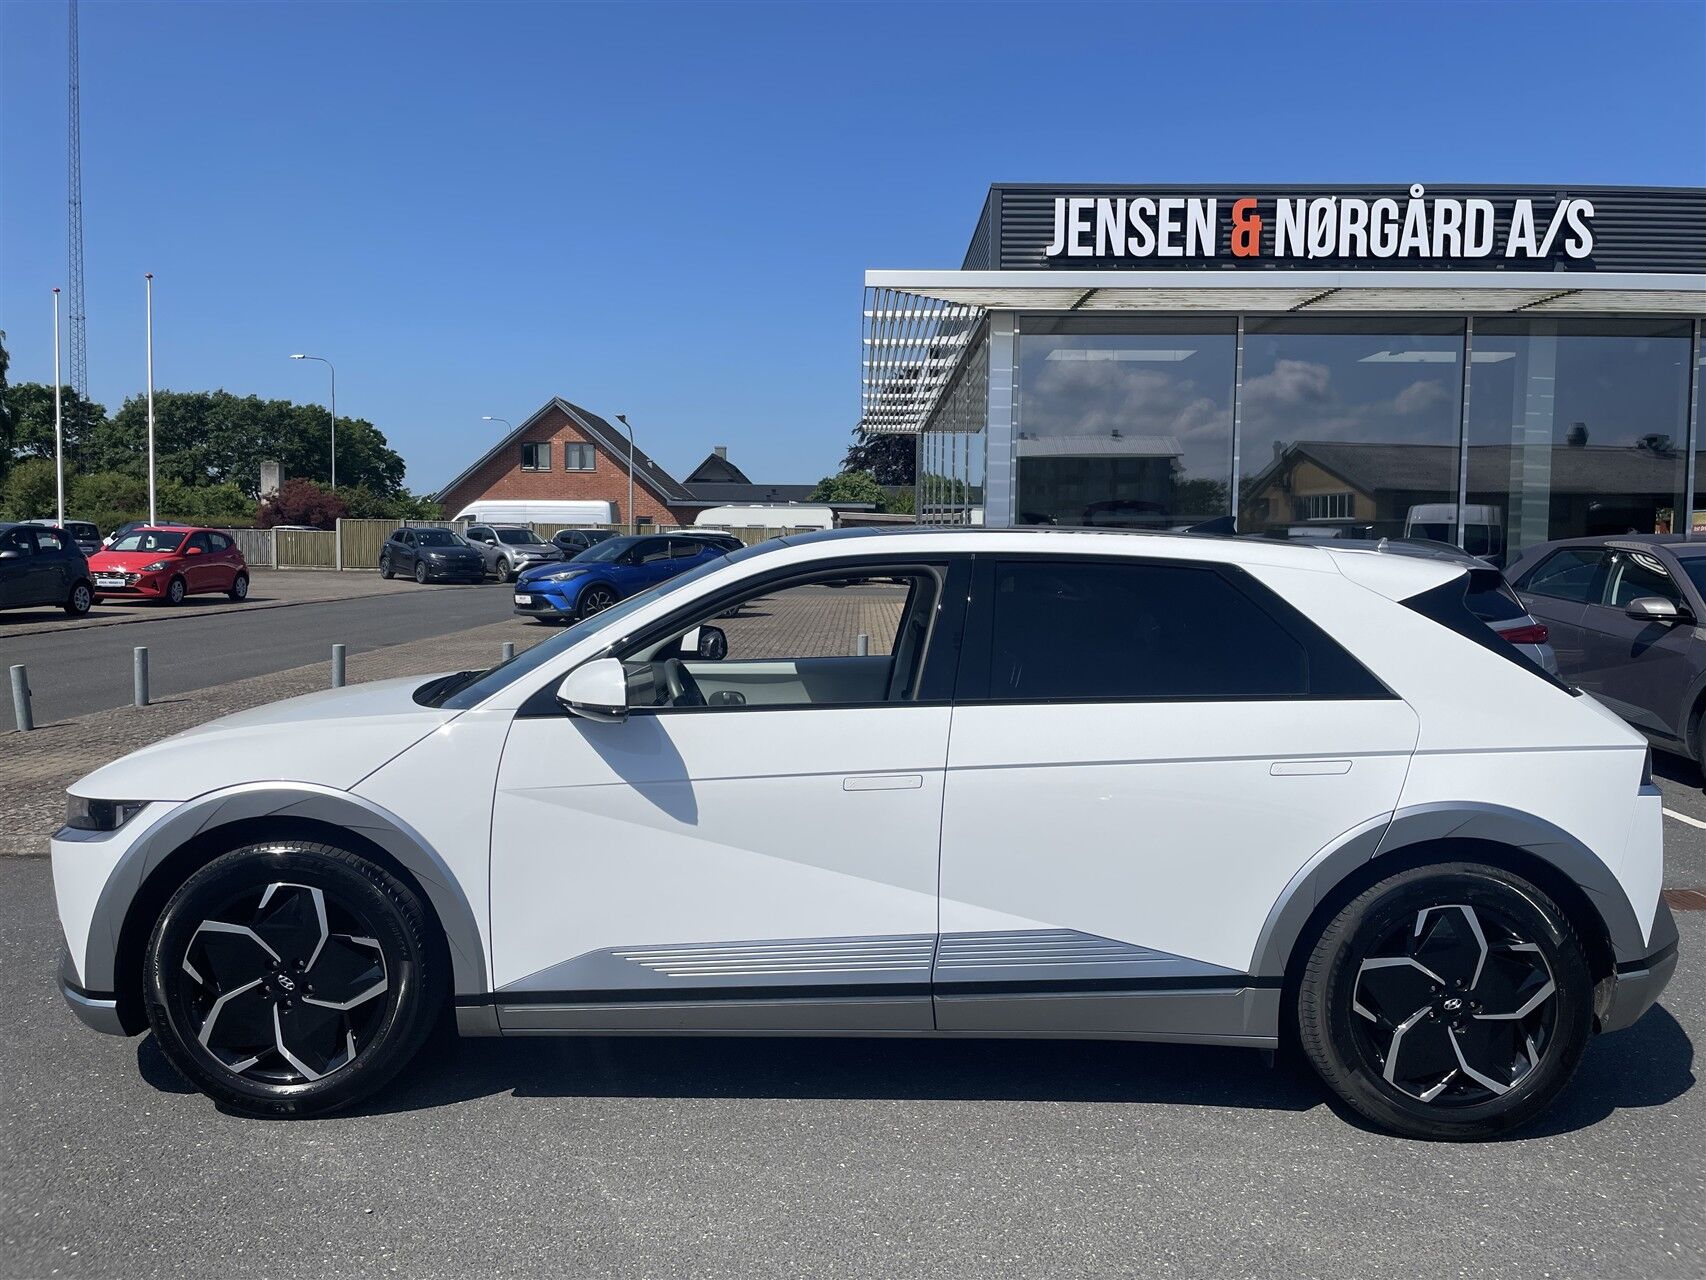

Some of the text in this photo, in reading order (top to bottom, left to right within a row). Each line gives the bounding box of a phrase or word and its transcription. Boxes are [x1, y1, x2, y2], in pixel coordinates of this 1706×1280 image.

[1045, 183, 1595, 259] JENSEN & NØRGÅRD A/S
